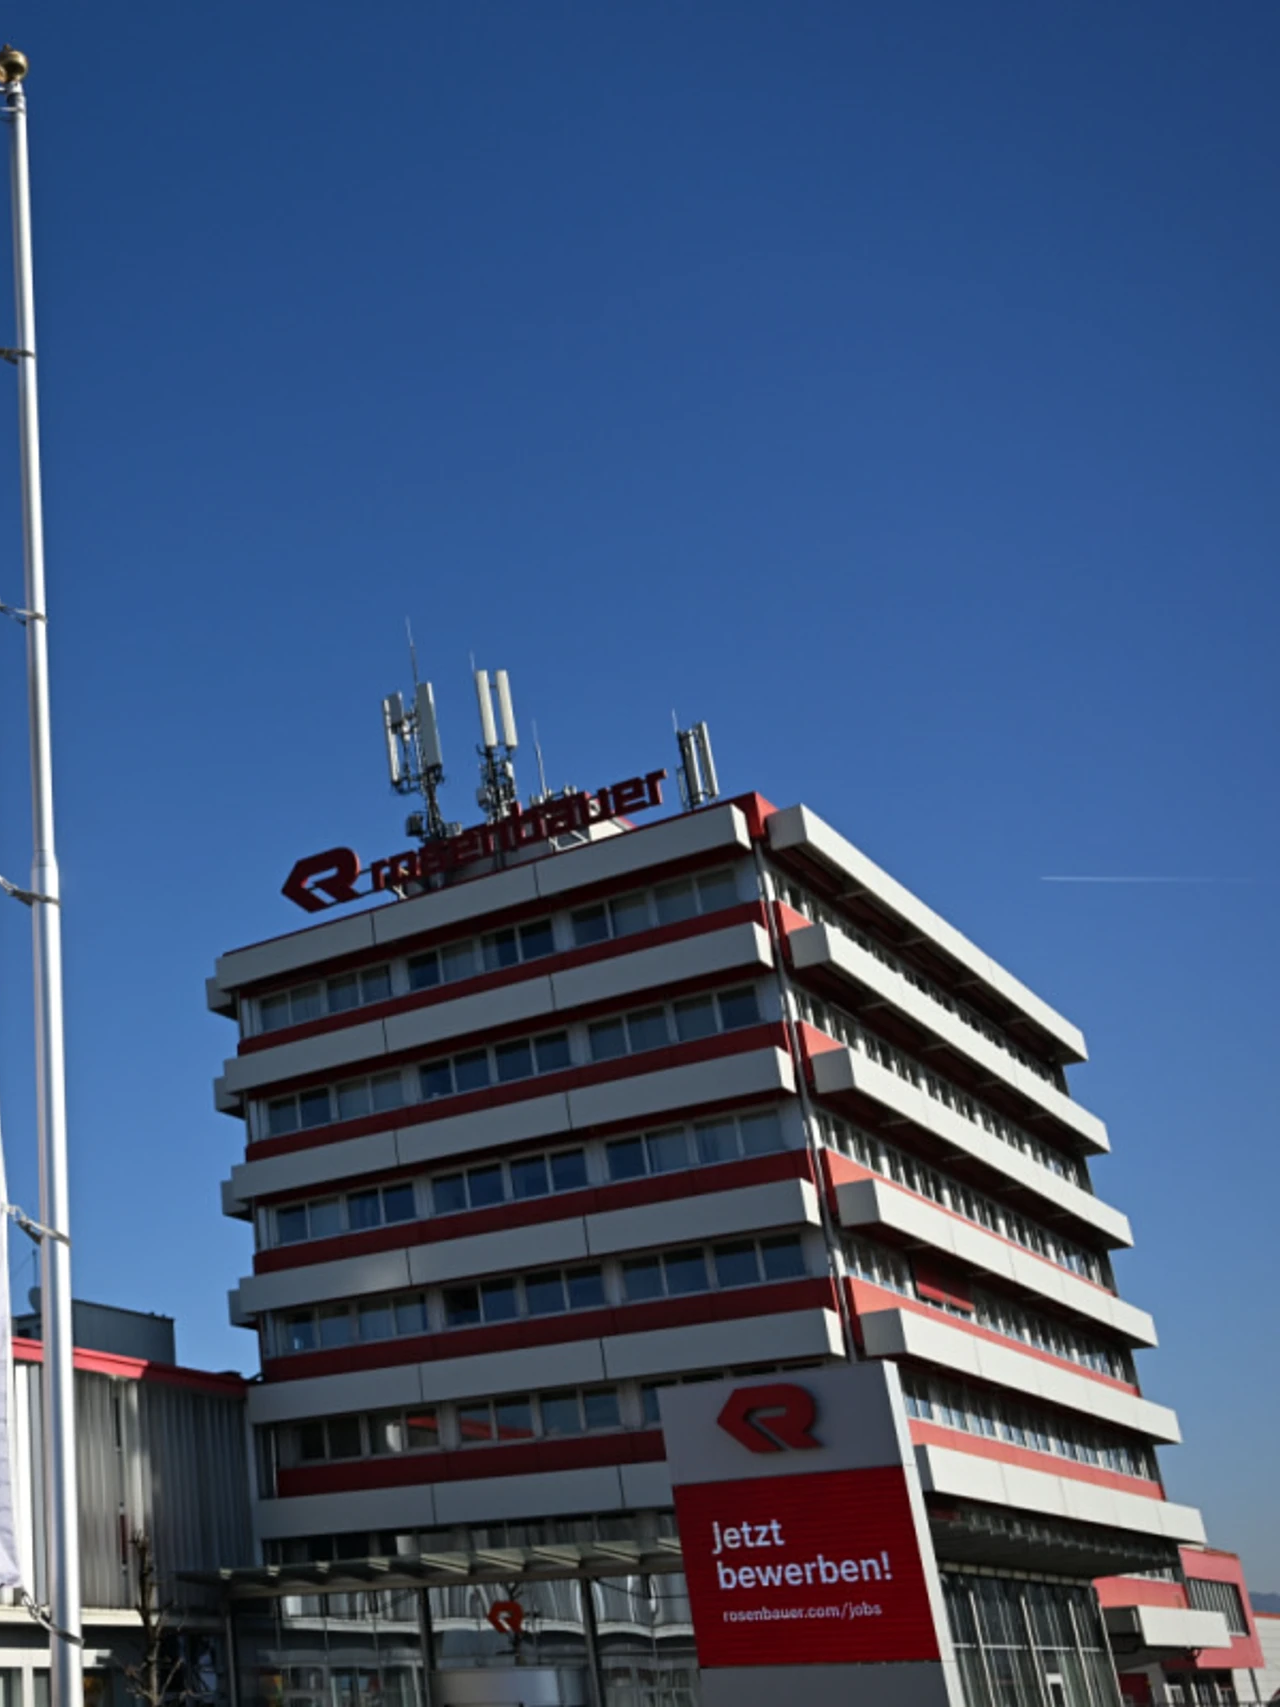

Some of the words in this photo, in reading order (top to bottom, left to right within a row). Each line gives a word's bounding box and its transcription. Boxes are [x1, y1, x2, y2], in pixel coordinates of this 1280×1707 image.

[371, 769, 667, 891] rosenbauer
[711, 1518, 786, 1555] Jetzt
[716, 1551, 894, 1590] bewerben!
[722, 1602, 882, 1622] rosenbauer.com/jobs
